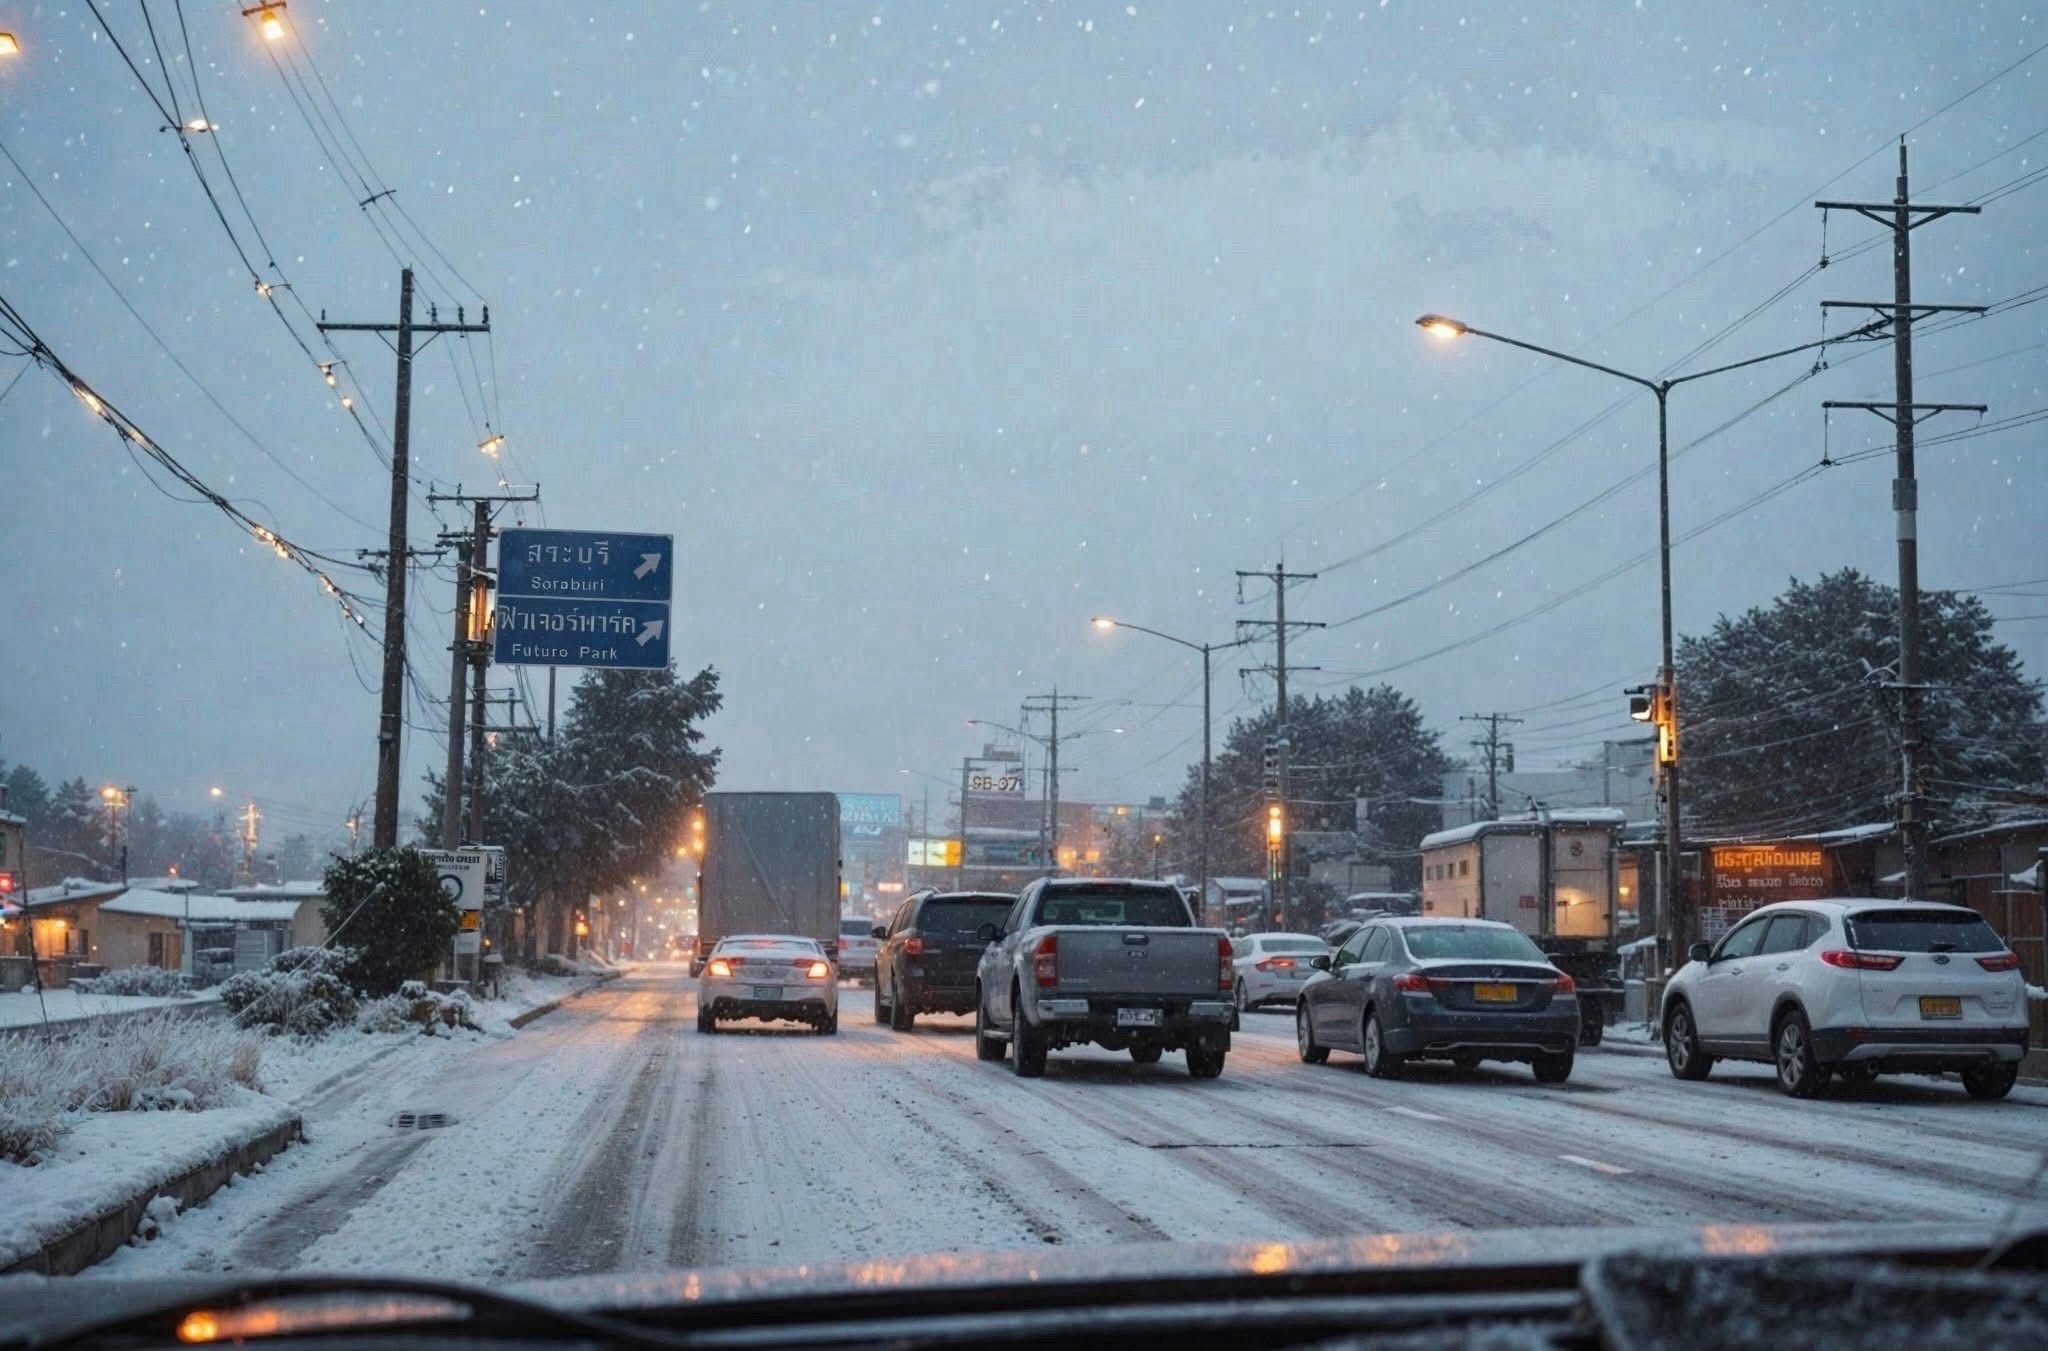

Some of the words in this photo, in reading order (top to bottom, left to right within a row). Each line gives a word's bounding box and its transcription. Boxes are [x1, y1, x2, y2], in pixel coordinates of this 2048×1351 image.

[528, 540, 609, 571] สระบุรี
[579, 646, 618, 660] Park
